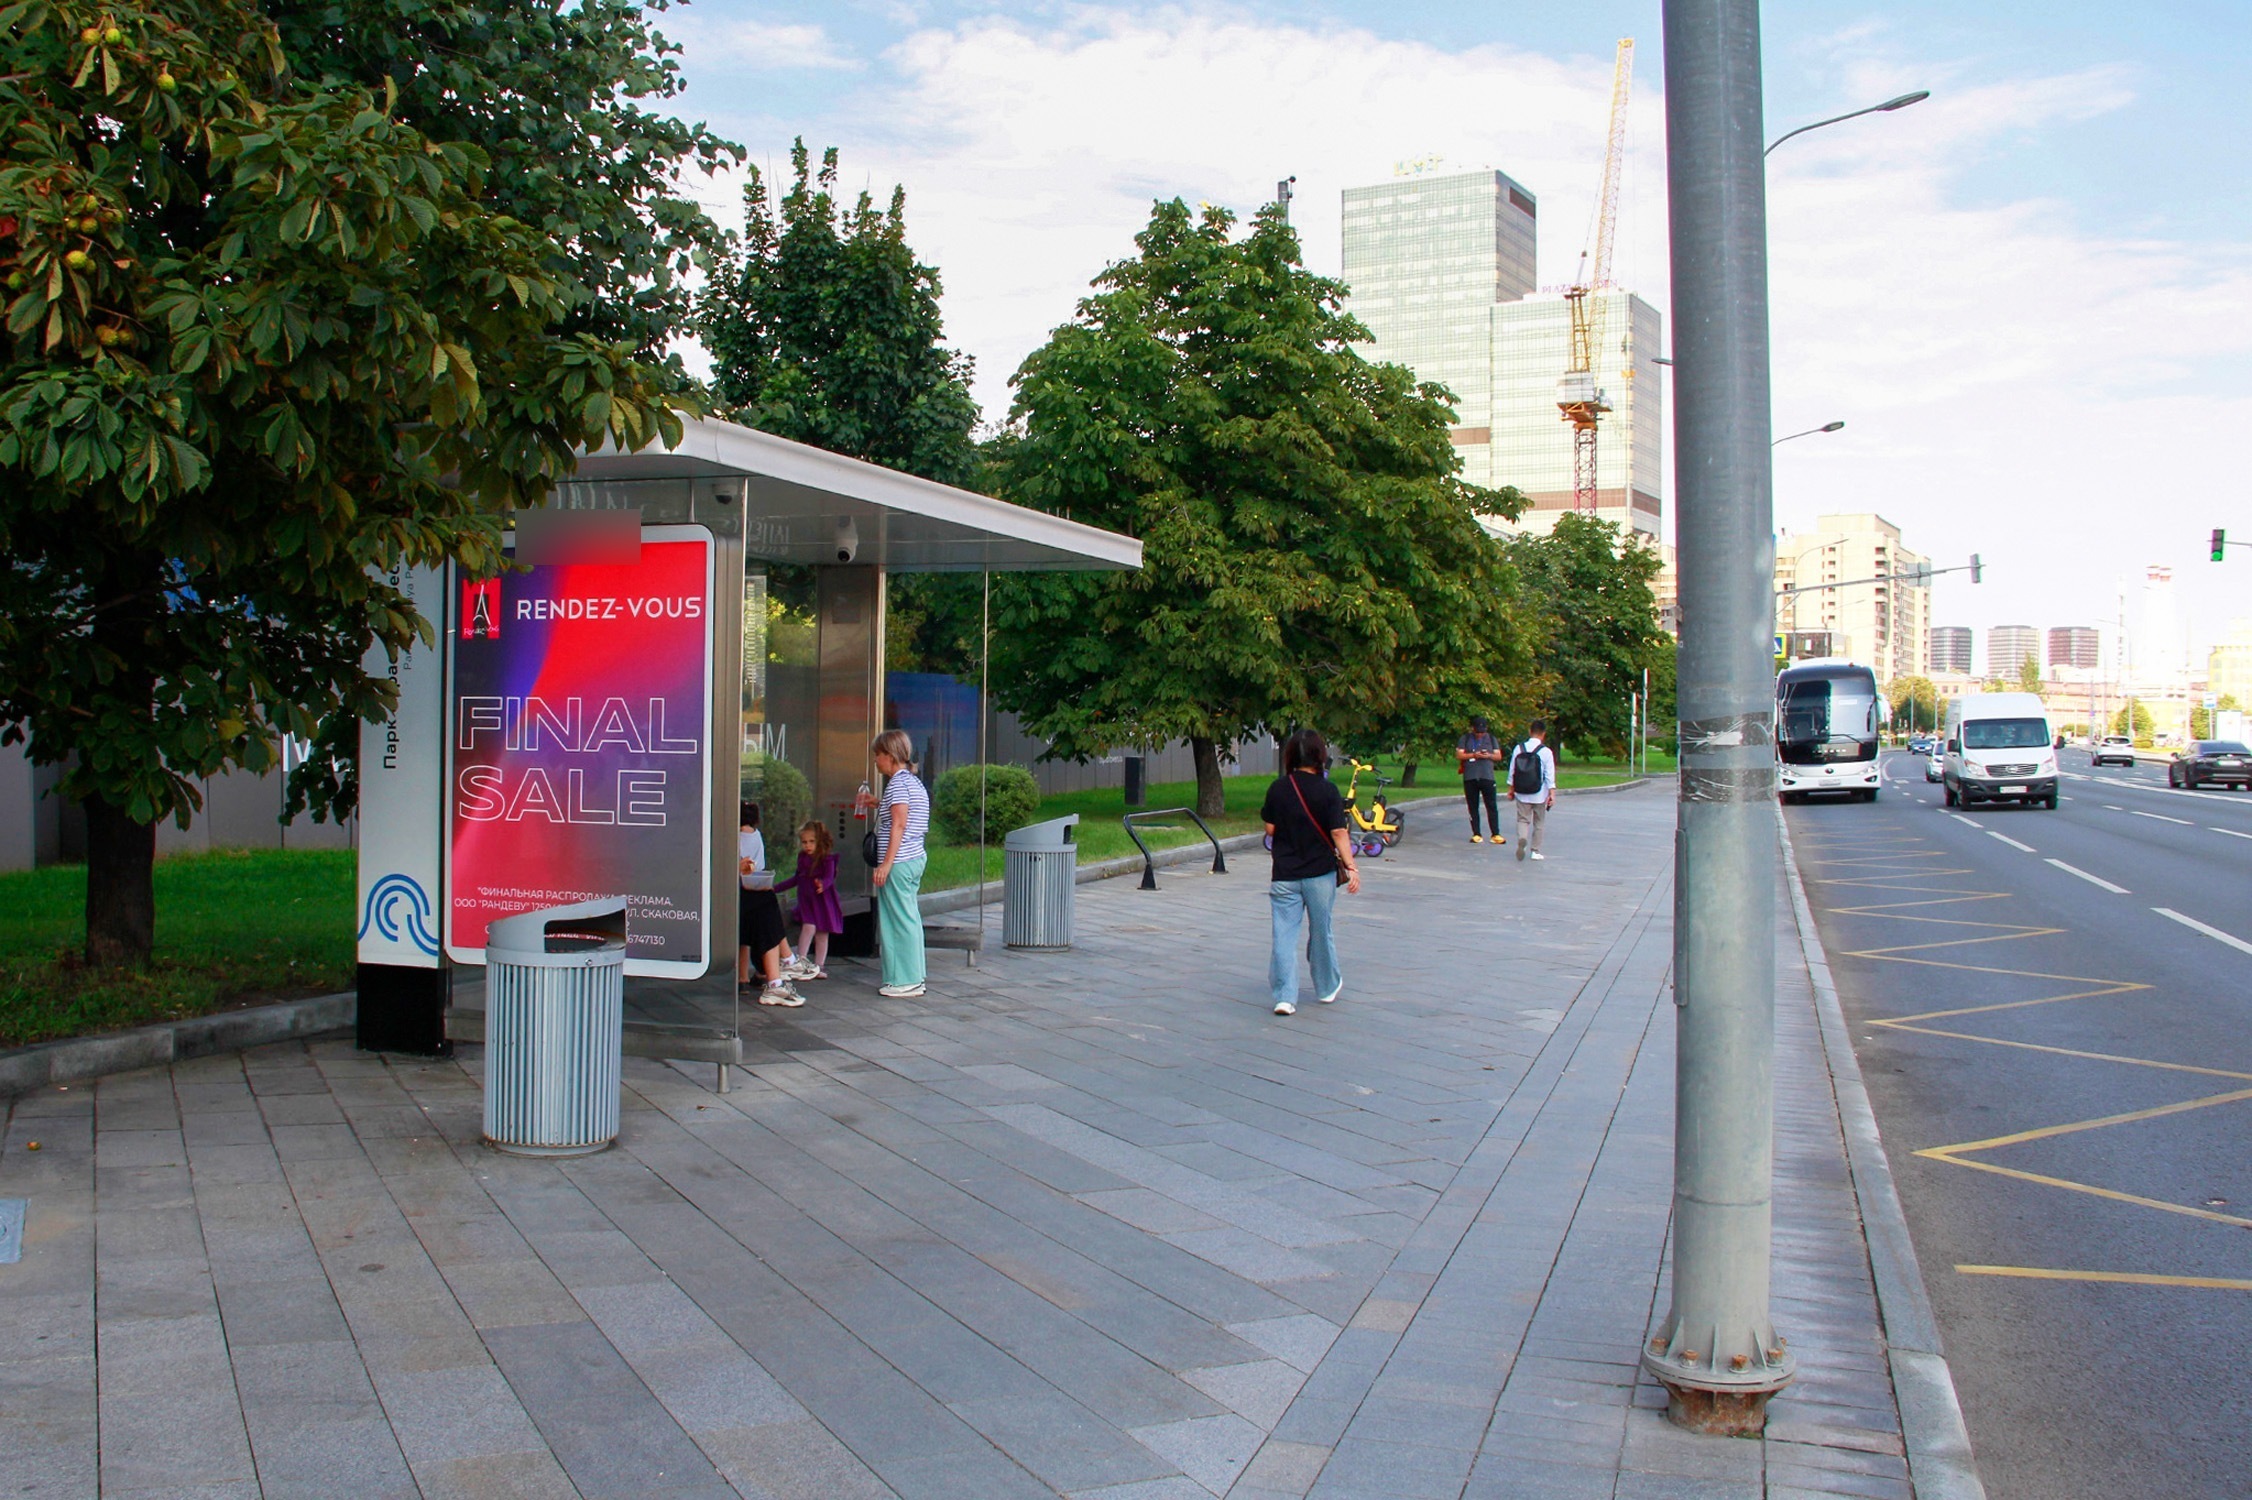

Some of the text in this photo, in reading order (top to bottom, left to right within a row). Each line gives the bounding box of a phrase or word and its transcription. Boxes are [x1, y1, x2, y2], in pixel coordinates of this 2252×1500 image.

[516, 596, 702, 620] RENDEZ-VOUS
[383, 719, 400, 769] Парк
[459, 695, 698, 755] FINAL
[459, 764, 668, 826] SALE
[454, 898, 477, 908] ООО
[478, 898, 530, 911] "РАНДЕВУ"
[641, 908, 701, 922] СКАКОВАЯ,
